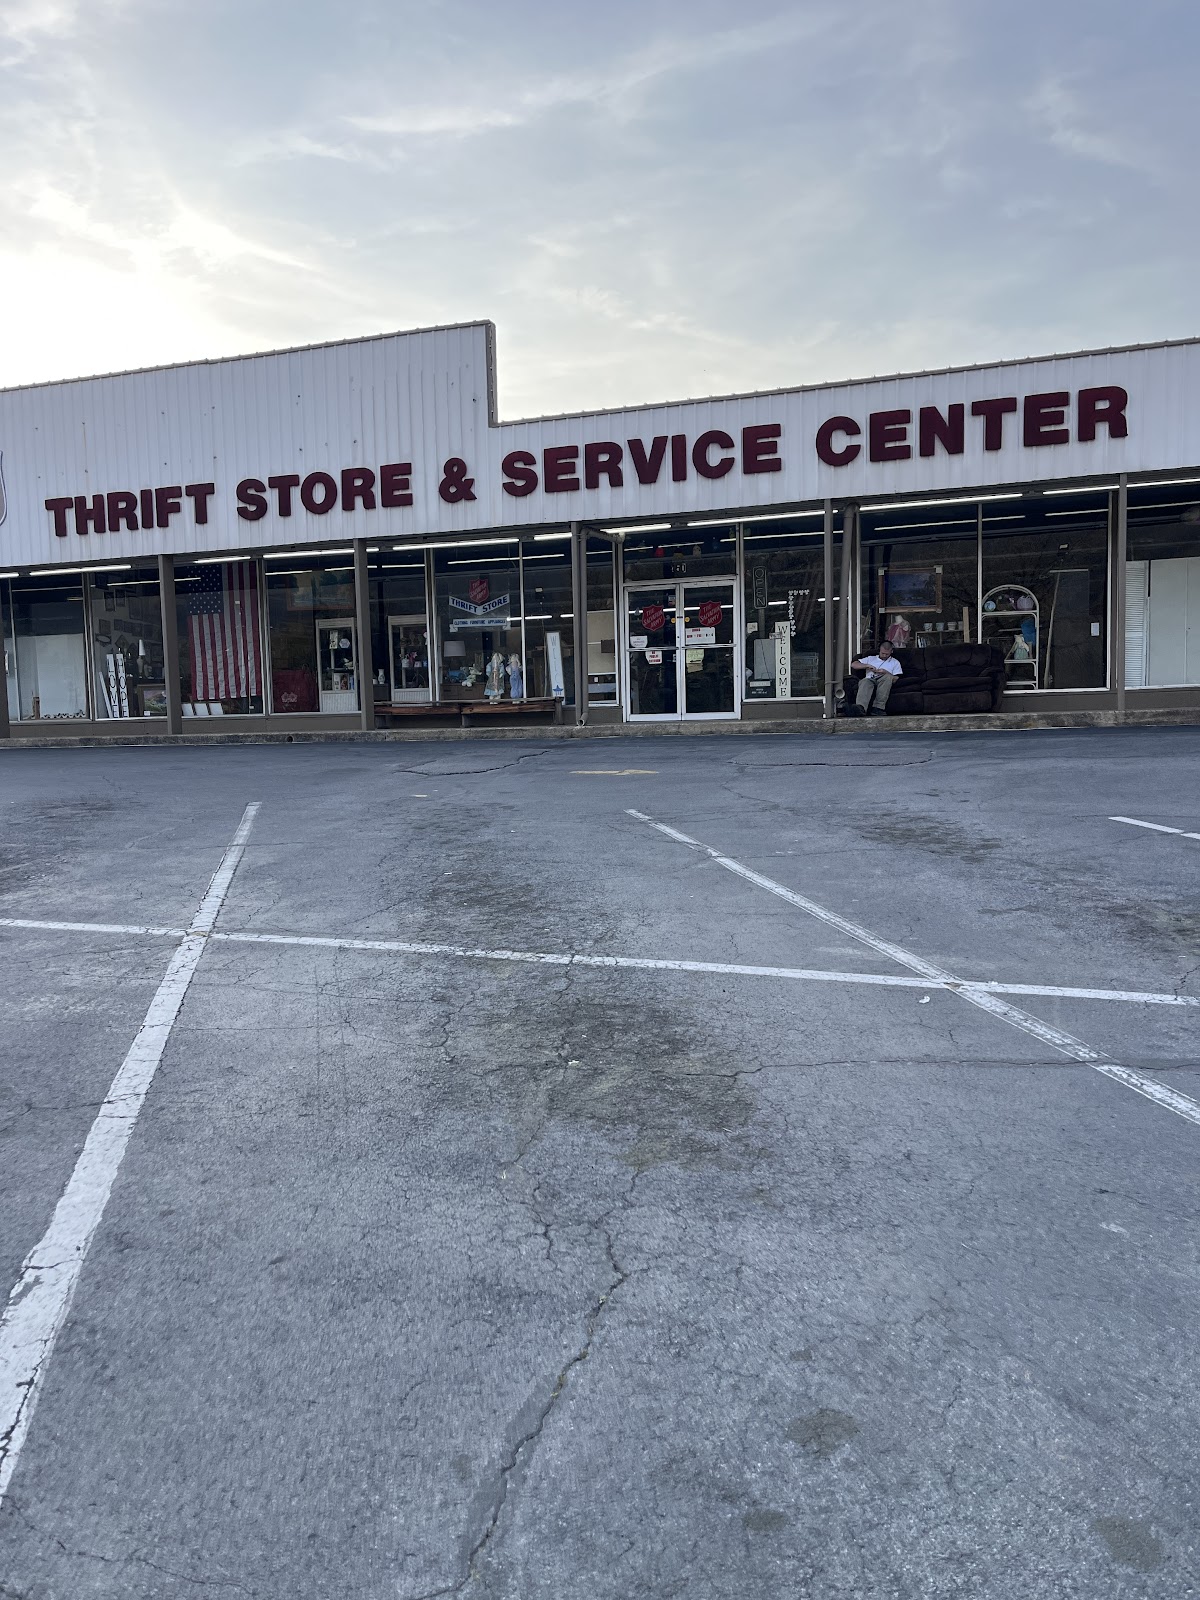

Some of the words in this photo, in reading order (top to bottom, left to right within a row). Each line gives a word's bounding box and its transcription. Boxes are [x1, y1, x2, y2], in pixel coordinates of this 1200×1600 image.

[45, 483, 215, 538] THRIFT
[236, 460, 413, 523] STORE
[438, 457, 478, 505] &
[501, 423, 783, 498] SERVICE
[815, 385, 1129, 469] CENTER
[754, 568, 765, 605] OPEN
[450, 597, 478, 613] THRIFT
[482, 595, 508, 612] STORE
[643, 609, 663, 625] SALVATION
[700, 606, 721, 622] SALVATION
[650, 616, 663, 629] ARMY
[707, 612, 720, 625] ARMY
[777, 625, 788, 697] WELCOME
[107, 659, 118, 718] LOVE
[117, 659, 128, 718] HOPE
